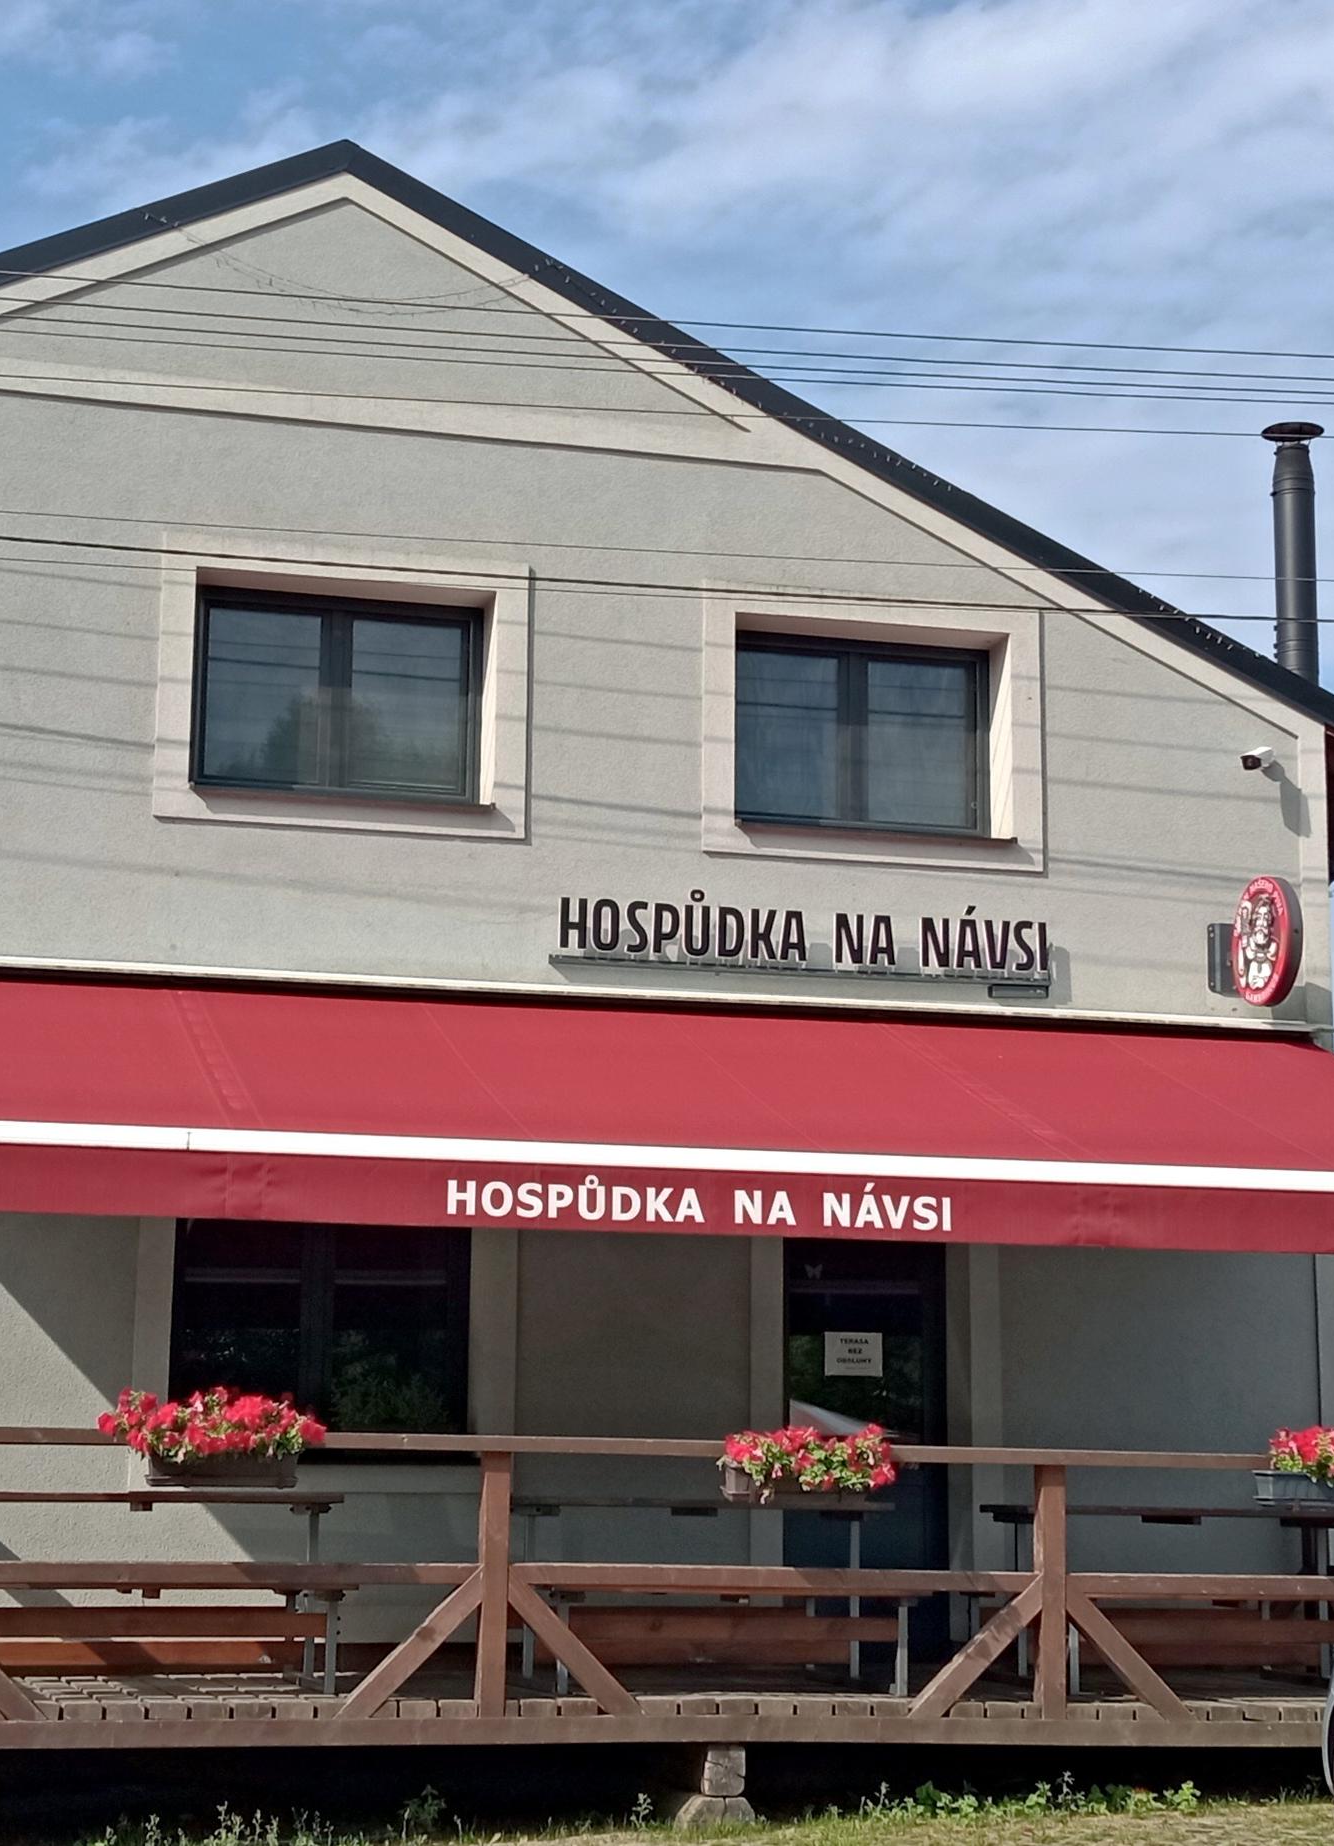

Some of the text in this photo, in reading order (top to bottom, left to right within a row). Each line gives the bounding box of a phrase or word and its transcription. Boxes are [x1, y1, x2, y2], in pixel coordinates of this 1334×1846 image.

[558, 889, 1049, 973] HOSPŮDKA NA NÁVSI
[446, 1175, 953, 1232] HOSPŮDKA NA NÁVSI
